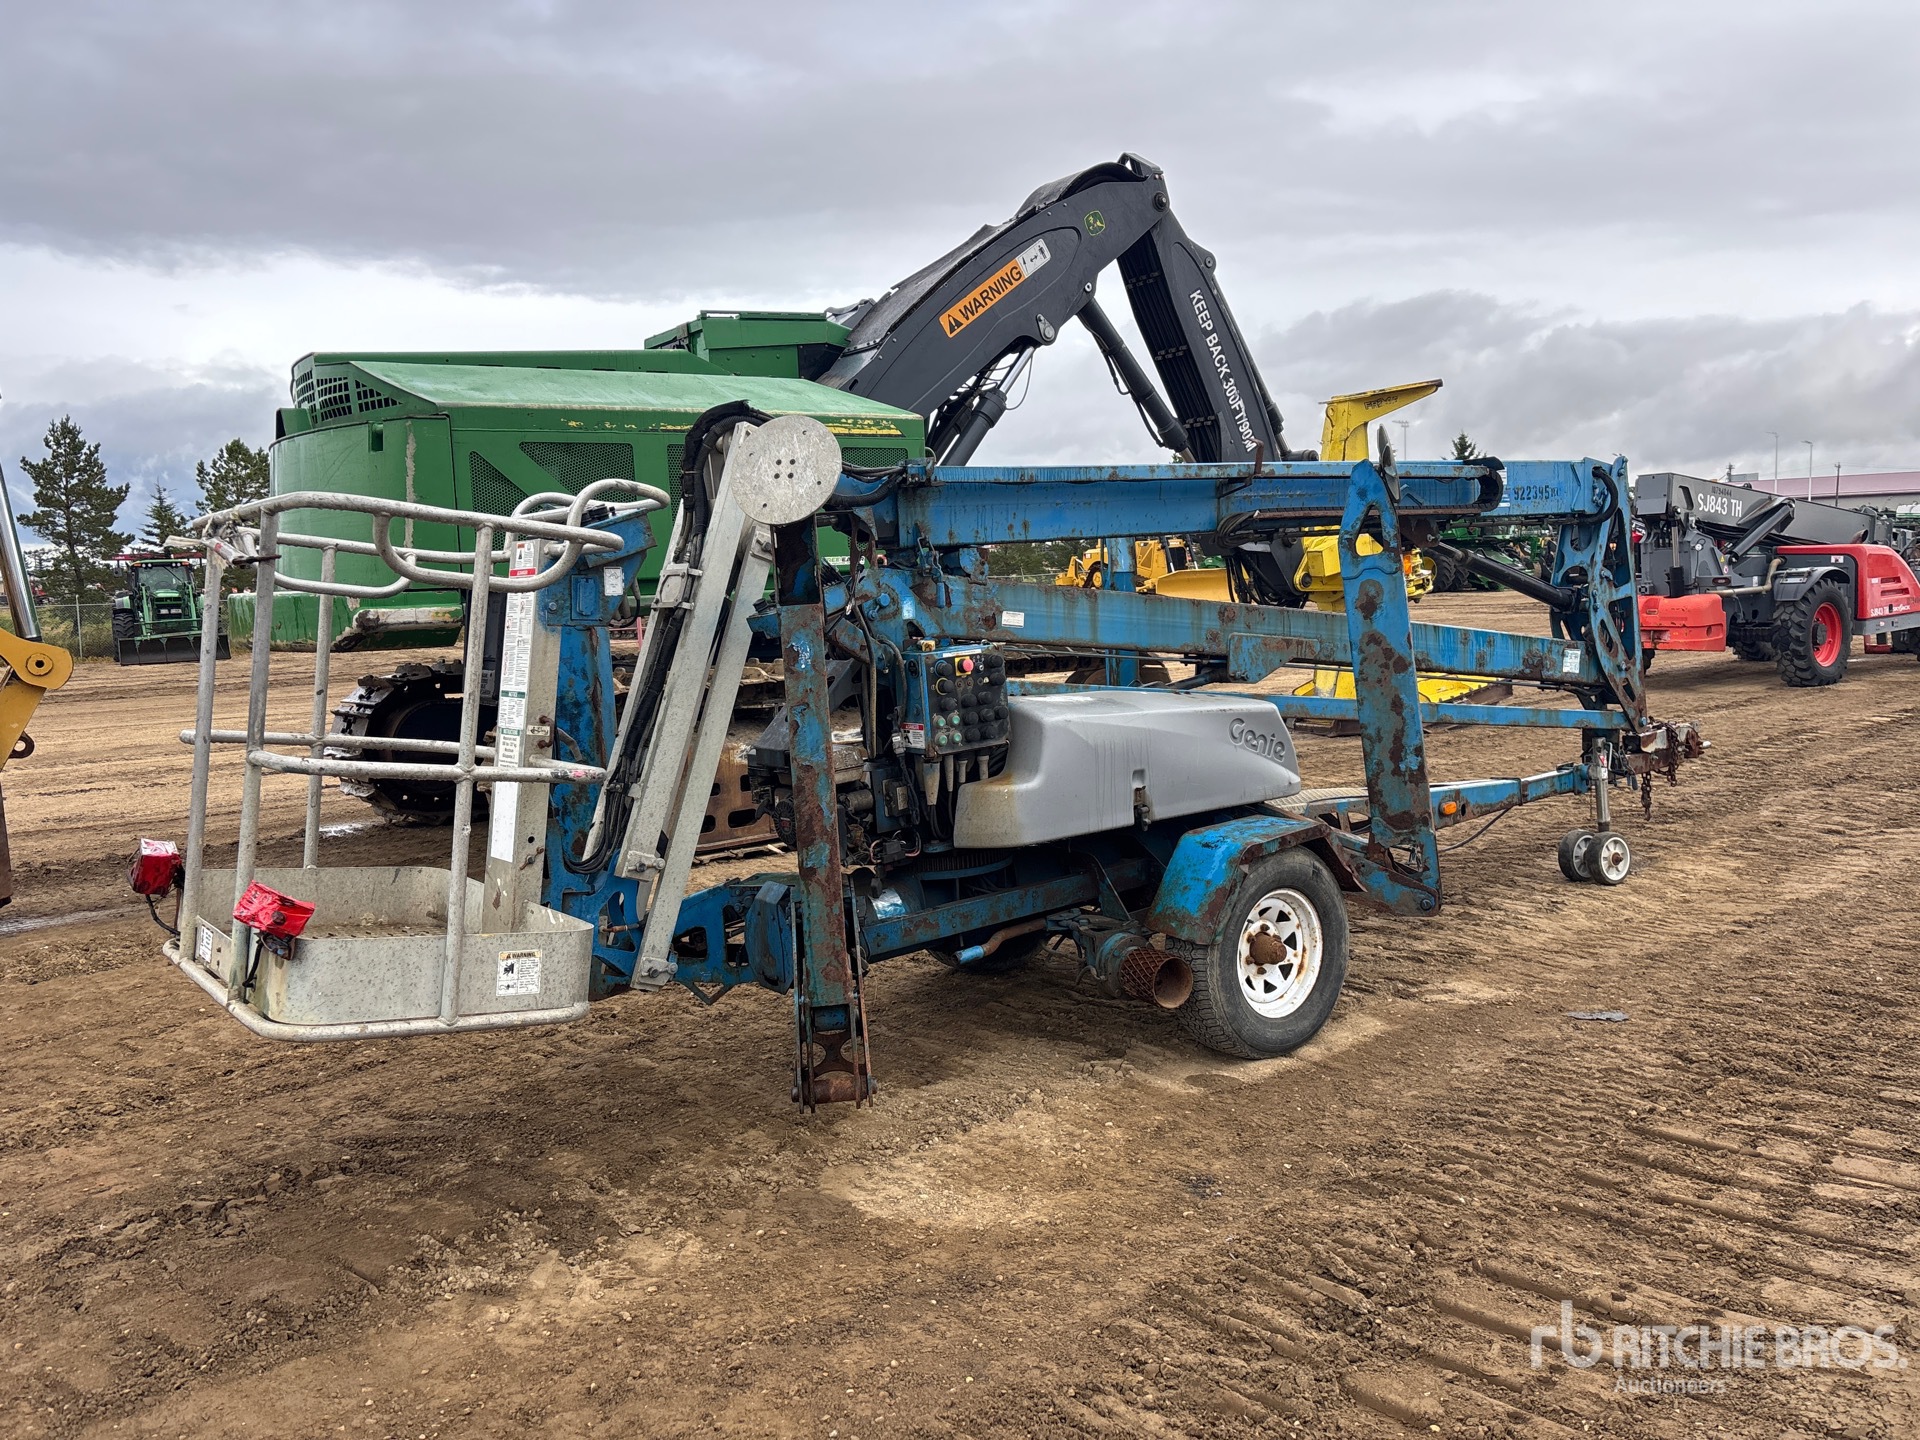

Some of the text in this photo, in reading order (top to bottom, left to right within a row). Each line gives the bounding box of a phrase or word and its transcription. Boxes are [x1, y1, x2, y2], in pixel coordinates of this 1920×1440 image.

[959, 266, 1022, 321] WARNING
[1190, 289, 1213, 331] KEEP
[1206, 333, 1231, 379] BACK
[1697, 493, 1743, 517] SJ843 TH
[1229, 717, 1286, 763] Genie
